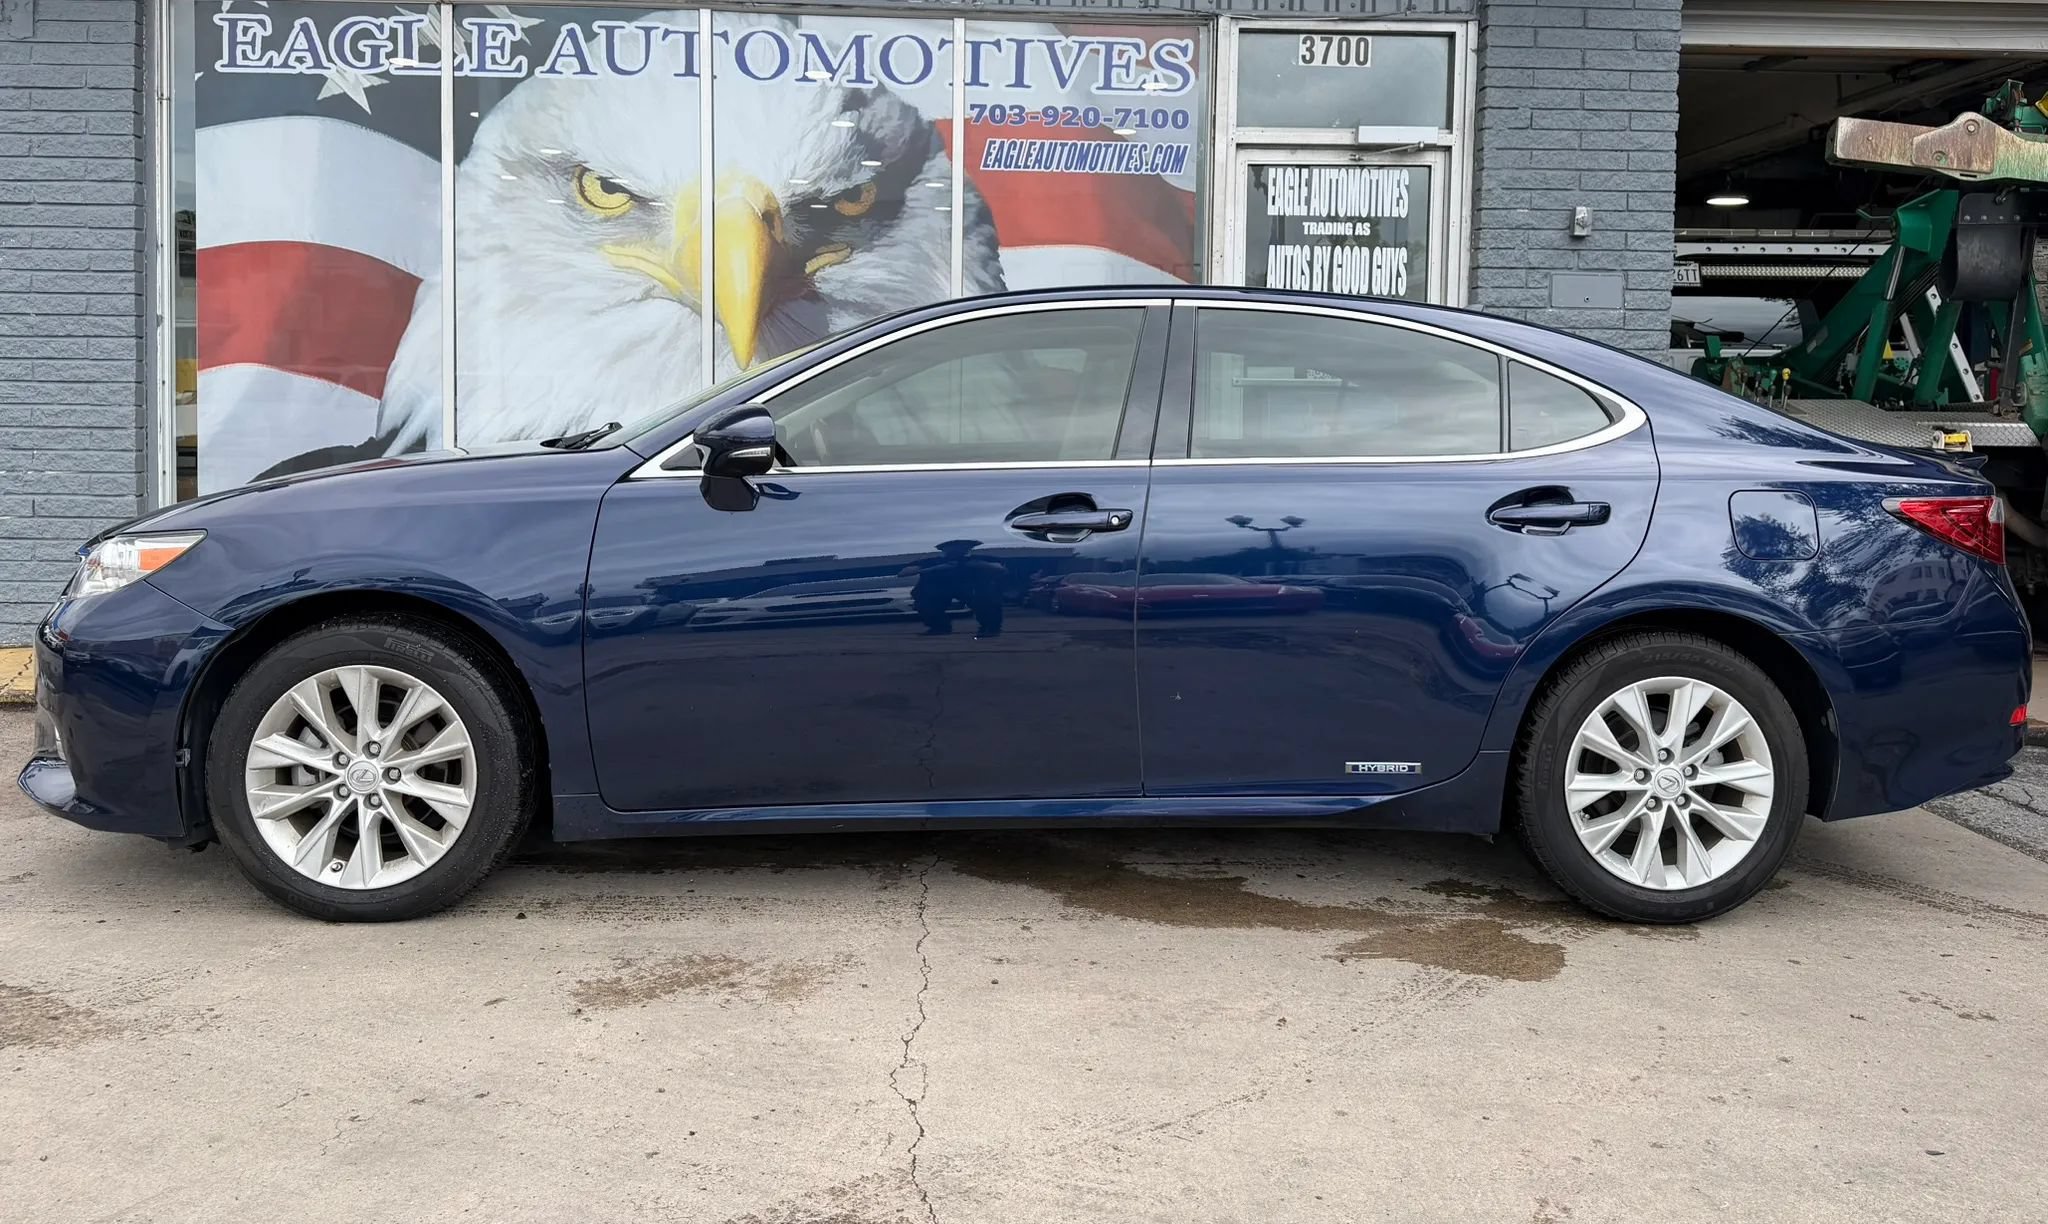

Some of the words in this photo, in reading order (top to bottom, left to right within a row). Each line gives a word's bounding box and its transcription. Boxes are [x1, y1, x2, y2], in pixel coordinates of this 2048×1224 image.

[214, 13, 527, 77] EAGLE
[535, 20, 1195, 96] AUTOMOTIVES
[1301, 35, 1369, 66] 3700
[969, 103, 1190, 130] 703-920-7100
[981, 138, 1190, 175] EAGLEAUTOMOTIVES.COM
[1267, 167, 1309, 216] EAGLE
[1309, 168, 1410, 218] AUTOMOTIVES
[1302, 221, 1353, 236] TRADING
[1354, 223, 1371, 236] AS
[1266, 244, 1310, 292] AUTOS
[1312, 246, 1331, 292] BY
[1332, 245, 1370, 295] GOOD
[1371, 246, 1408, 296] GUYS
[1359, 764, 1409, 772] HYBRID
